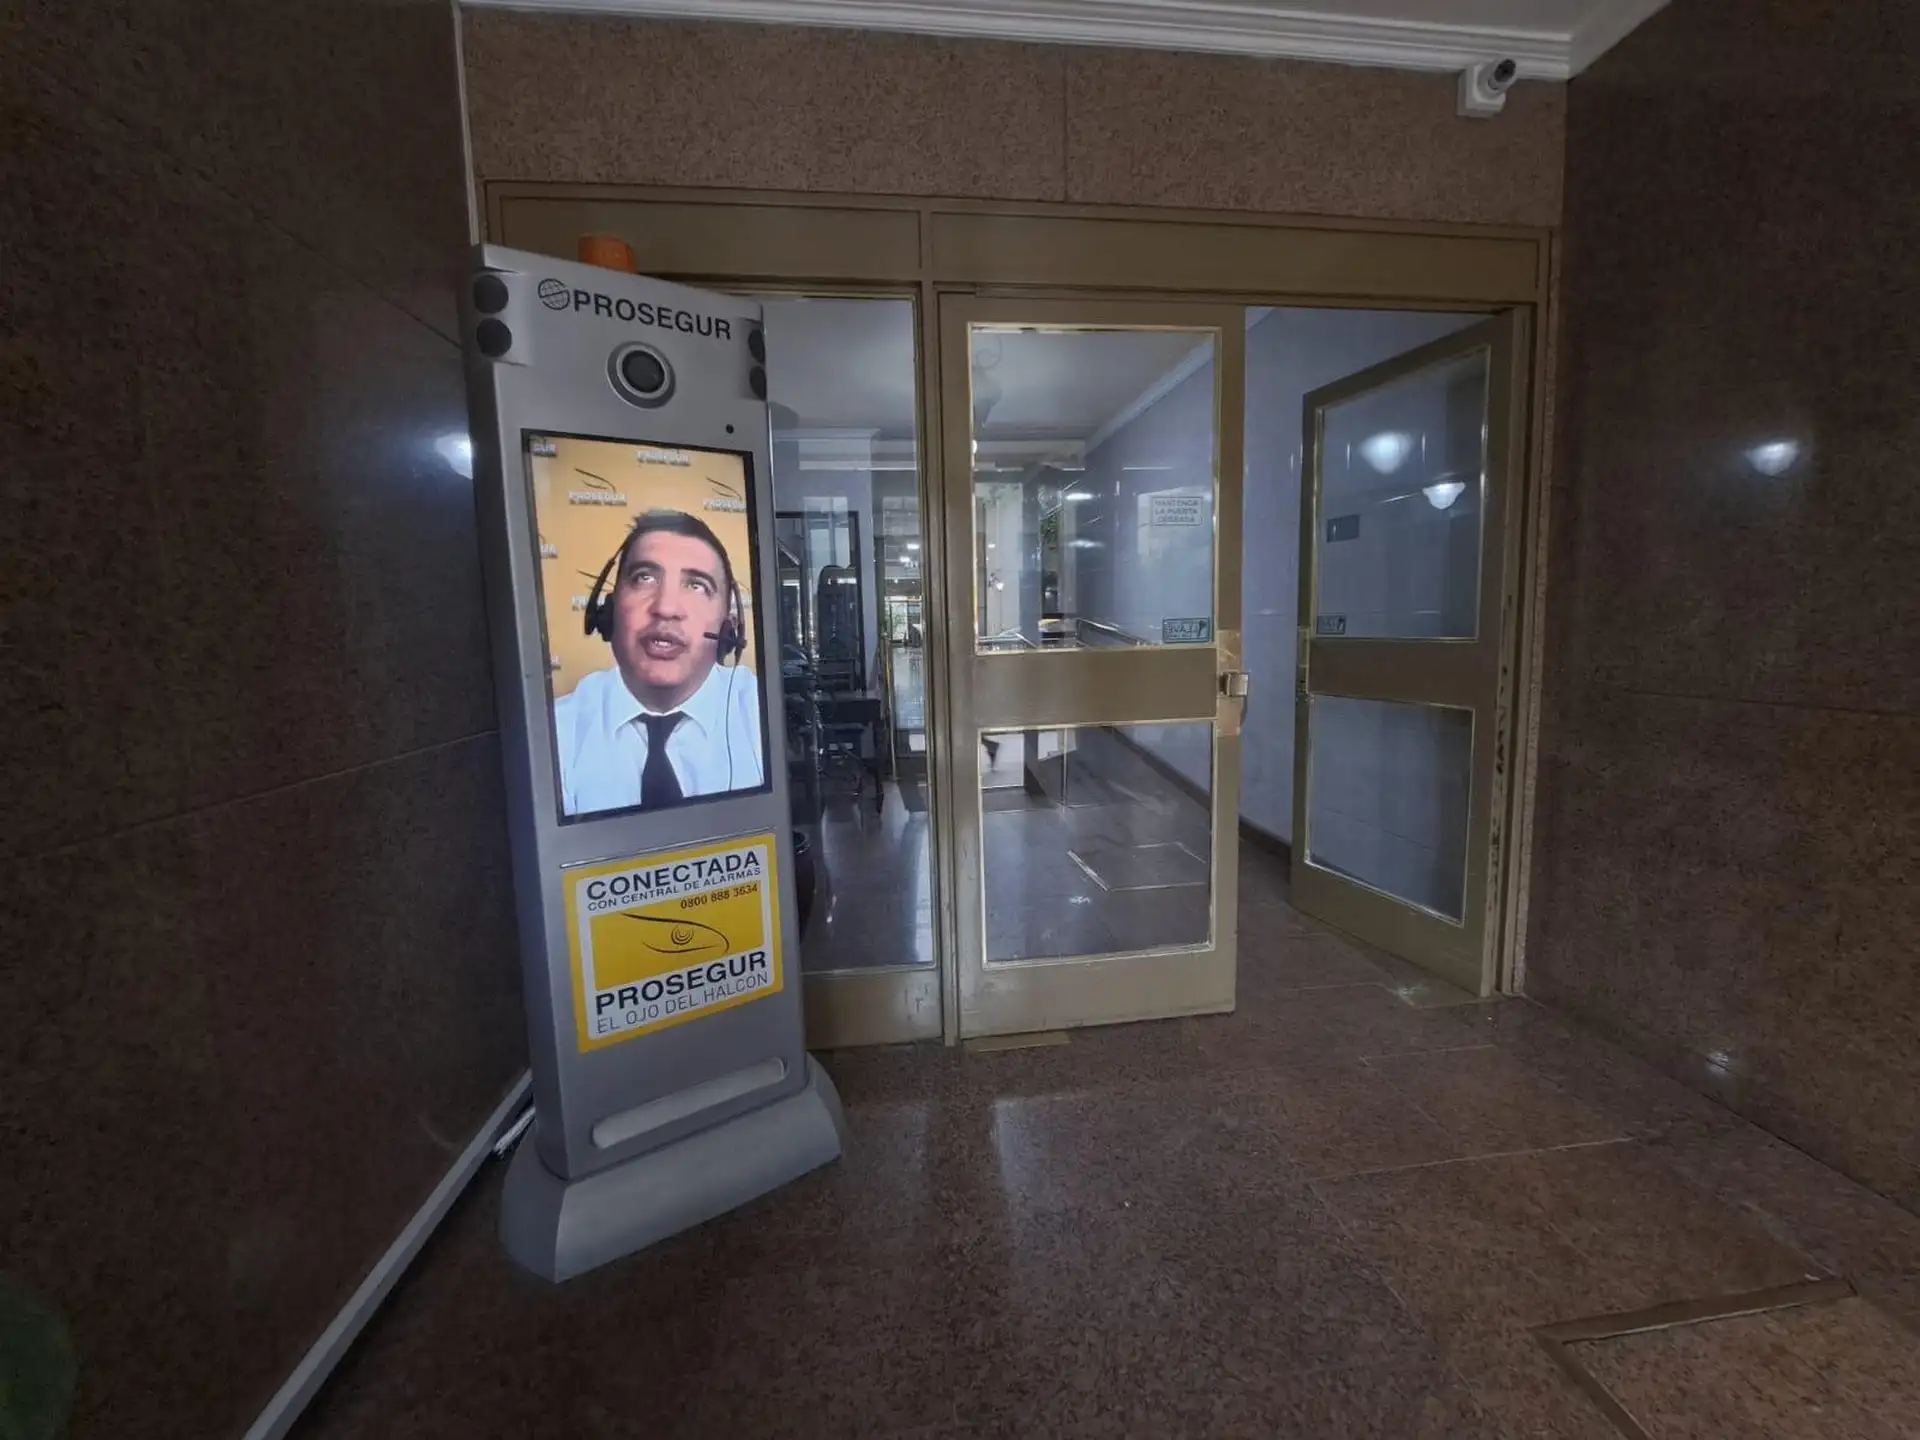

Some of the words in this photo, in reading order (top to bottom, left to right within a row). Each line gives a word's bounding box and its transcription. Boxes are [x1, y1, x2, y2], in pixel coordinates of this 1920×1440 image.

[573, 287, 732, 340] PROSEGUR
[586, 850, 760, 902] CONECTADA
[587, 896, 617, 912] CON
[622, 886, 680, 906] CENTRAL
[683, 881, 700, 892] DE
[703, 867, 761, 888] ALARMAS
[680, 896, 708, 910] 0800
[595, 950, 767, 1016] PROSEGUR
[597, 1016, 620, 1034] EL
[626, 1002, 659, 1025] OJO
[666, 995, 699, 1016] DEL
[703, 971, 768, 1003] HALCON
